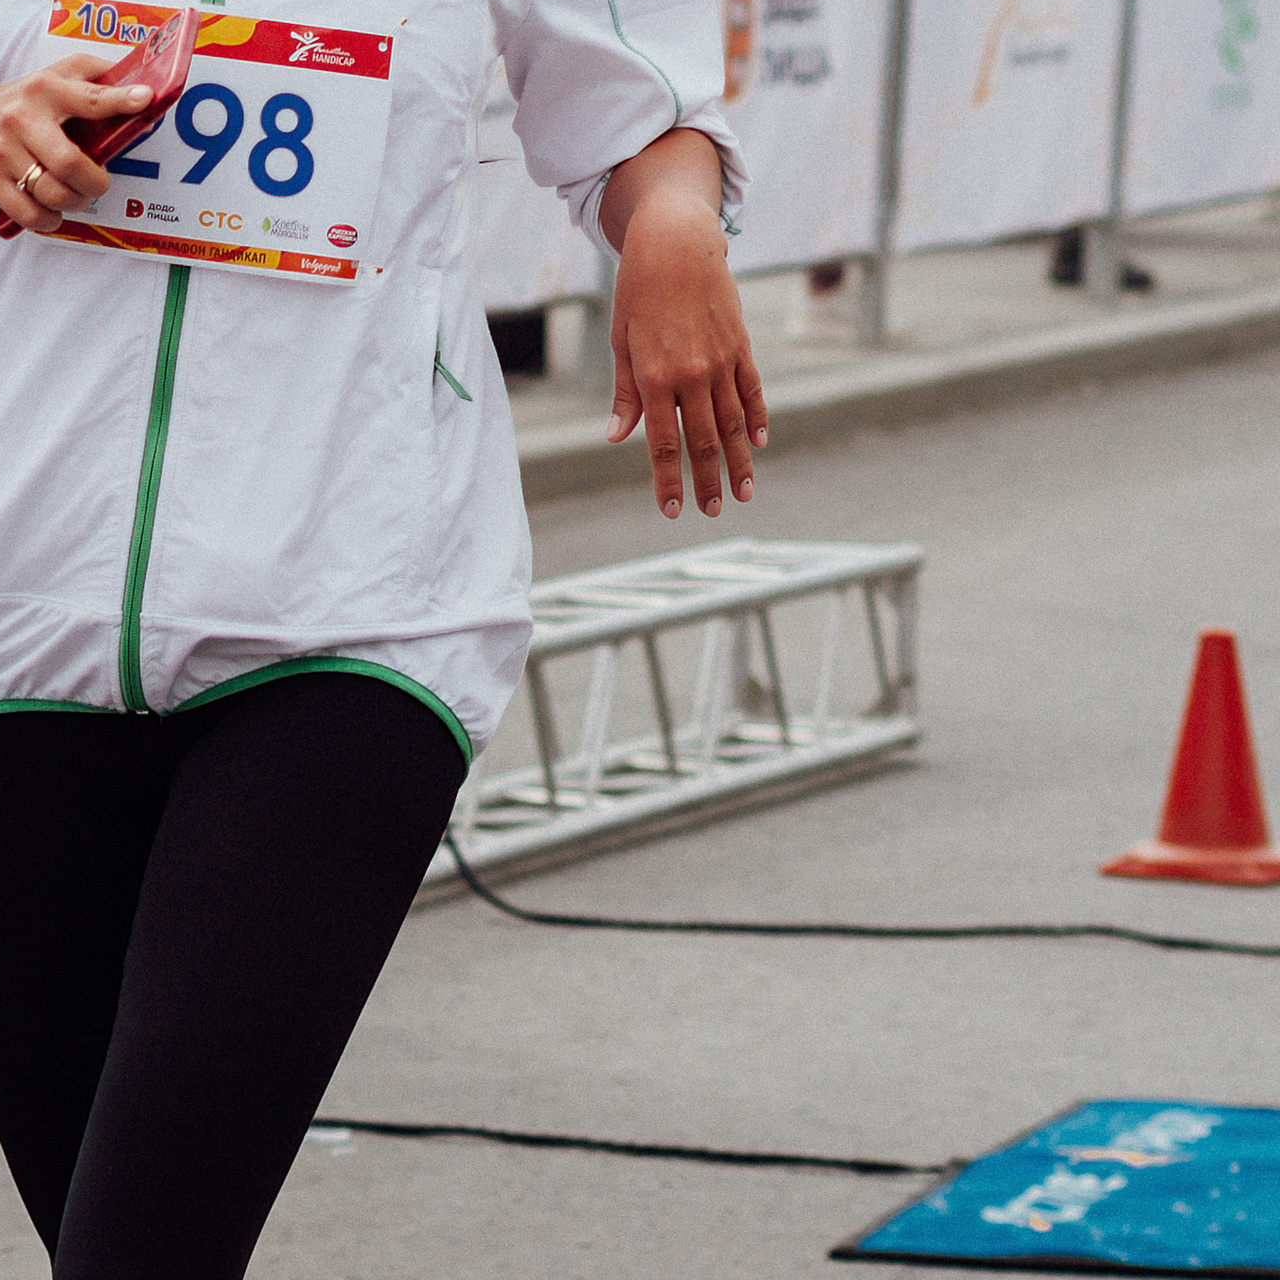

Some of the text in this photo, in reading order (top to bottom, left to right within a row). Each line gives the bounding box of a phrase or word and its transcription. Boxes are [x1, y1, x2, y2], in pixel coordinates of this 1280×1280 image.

[75, 1, 118, 39] 10
[312, 53, 355, 66] HANDICAP
[199, 210, 243, 230] СТС
[122, 234, 266, 264] ПОЛУМАРАФОН ГАНДИКАП
[301, 258, 341, 274] Volgograd
